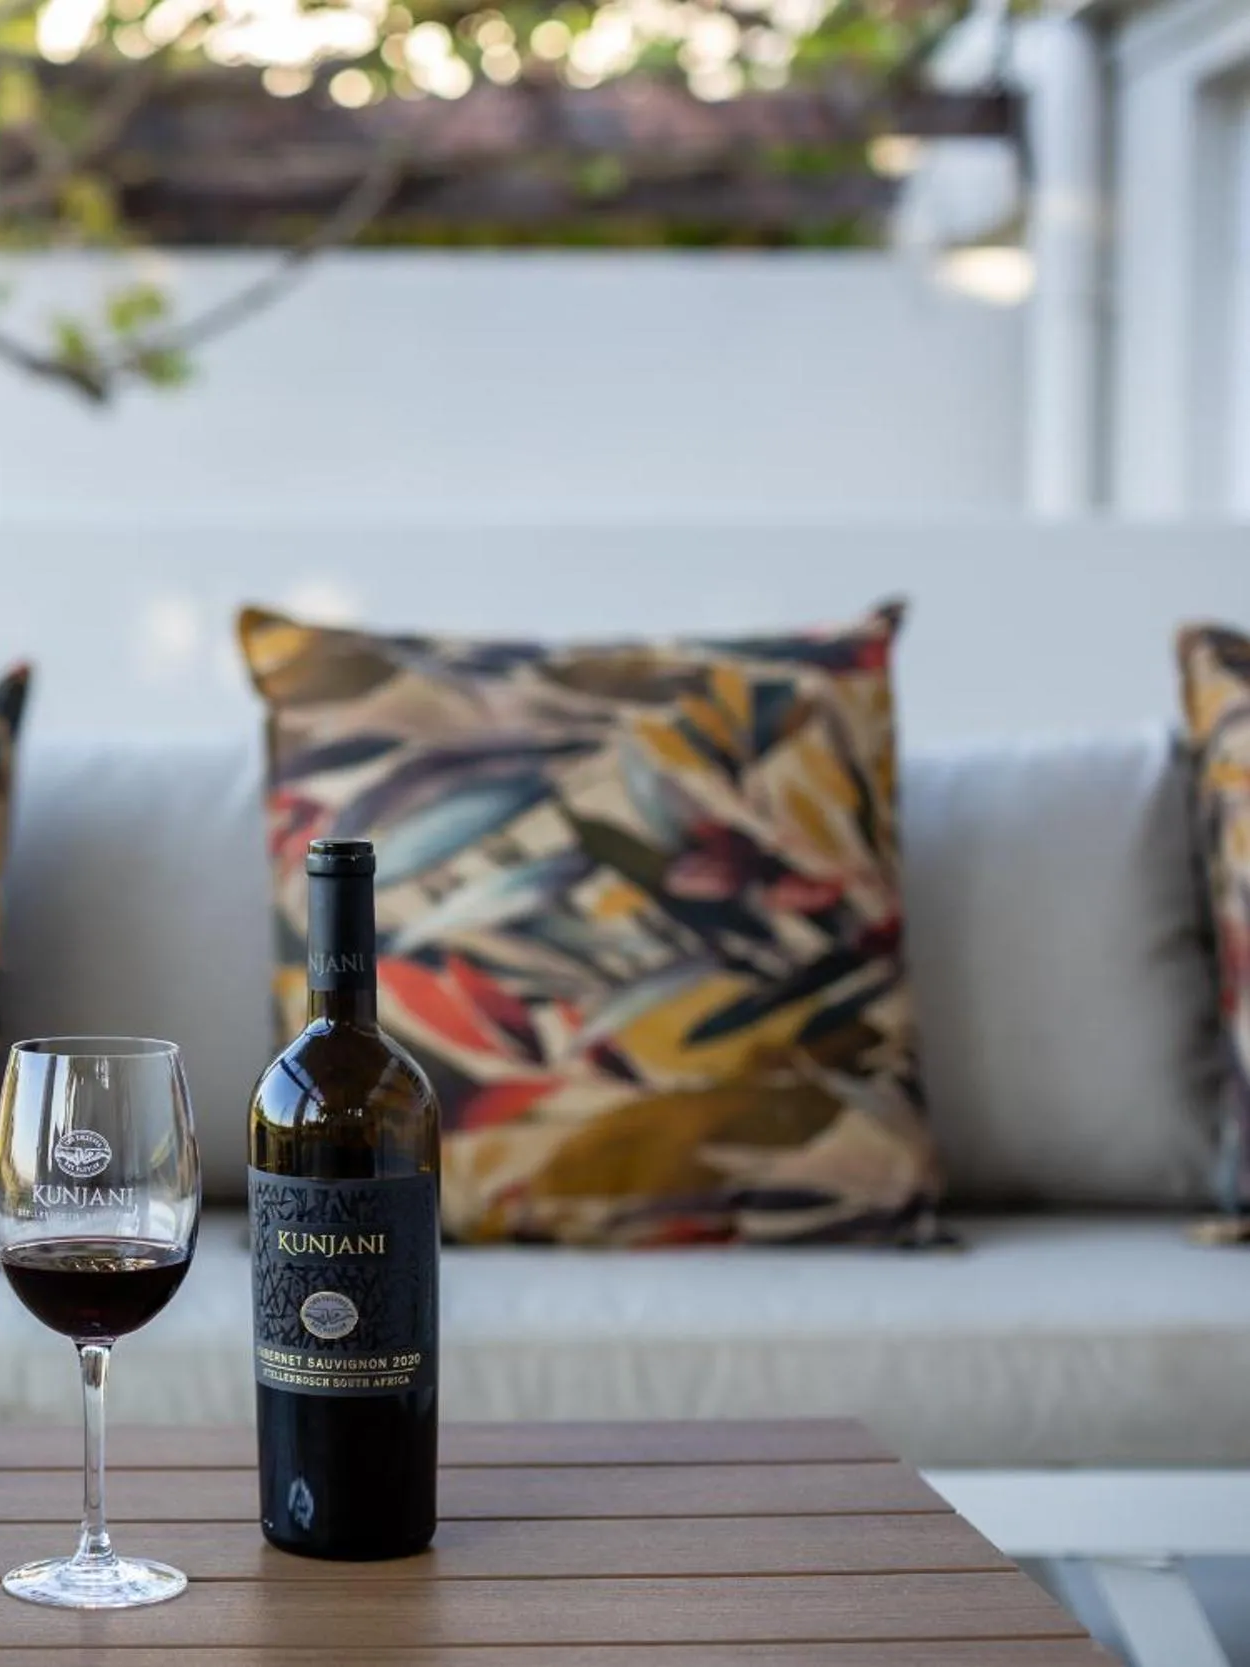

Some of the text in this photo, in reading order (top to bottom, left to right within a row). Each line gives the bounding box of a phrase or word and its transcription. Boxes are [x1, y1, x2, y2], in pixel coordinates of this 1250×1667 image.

[32, 1184, 134, 1209] KUNJANI
[277, 1230, 386, 1258] KUNJANI
[257, 1346, 421, 1370] ABERNET SAUVIGNON 2020
[332, 1376, 369, 1388] SOUTH
[372, 1374, 410, 1388] AFRICA
